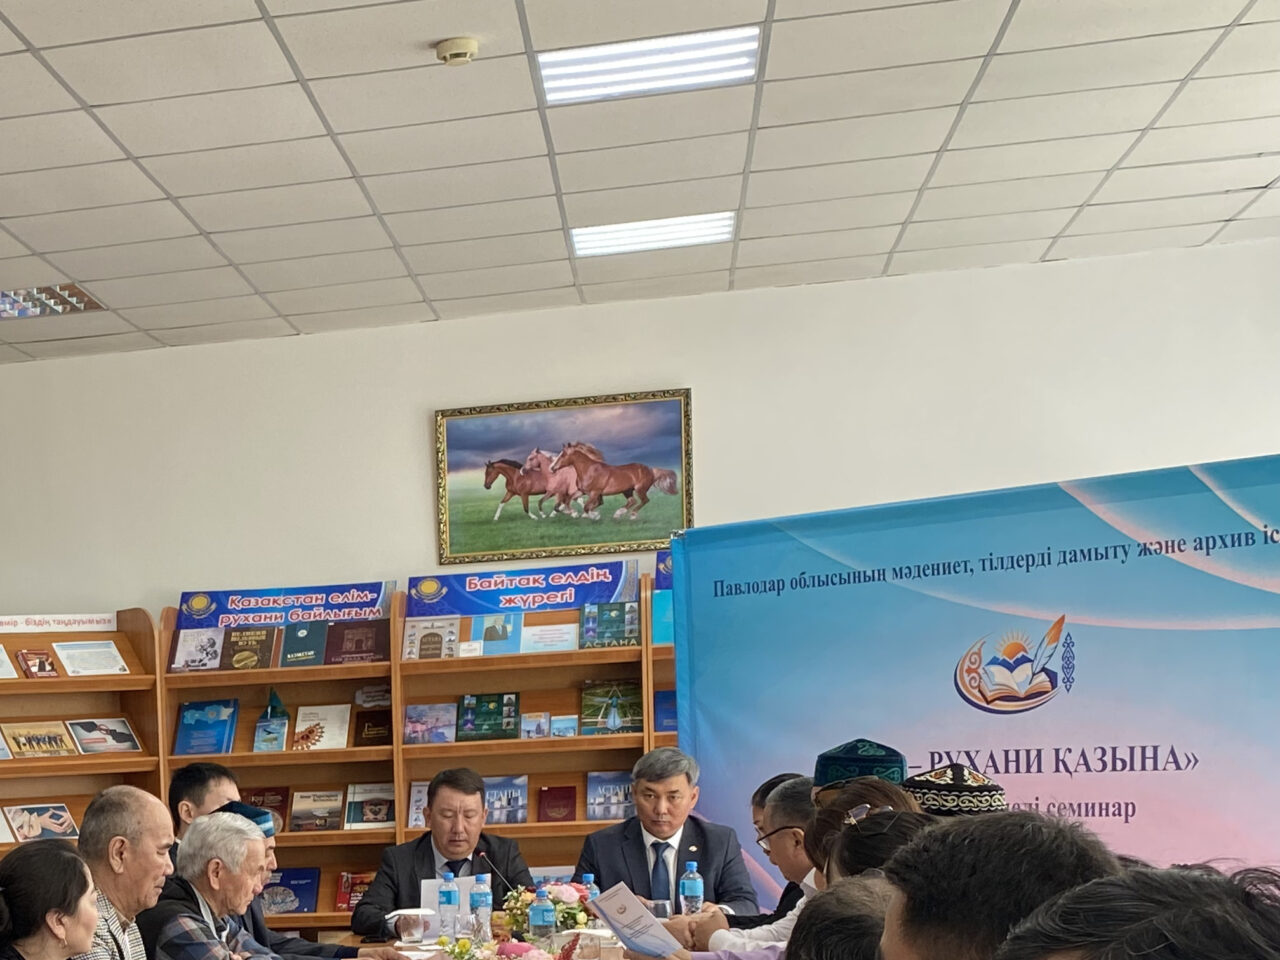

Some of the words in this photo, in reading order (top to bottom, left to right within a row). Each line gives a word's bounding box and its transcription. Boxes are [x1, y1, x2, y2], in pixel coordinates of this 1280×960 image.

[713, 577, 785, 598] Павлодар
[790, 567, 887, 590] облысының
[892, 559, 974, 581] мәдениет,
[979, 547, 1051, 573] тілдерді
[1057, 543, 1131, 567] дамыту
[1137, 537, 1187, 557] және
[1193, 531, 1256, 556] архив
[466, 573, 545, 591] Байтақ
[549, 567, 611, 584] елдің
[229, 593, 325, 609] Қазақстан
[329, 589, 377, 604] елім-
[500, 588, 575, 608] жүрегі
[219, 612, 284, 627] рухани
[289, 606, 383, 622] байлығым
[584, 638, 639, 649] АСТАНА
[1052, 744, 1200, 780] ҚАЗЫНА»
[1047, 799, 1137, 823] семинар
